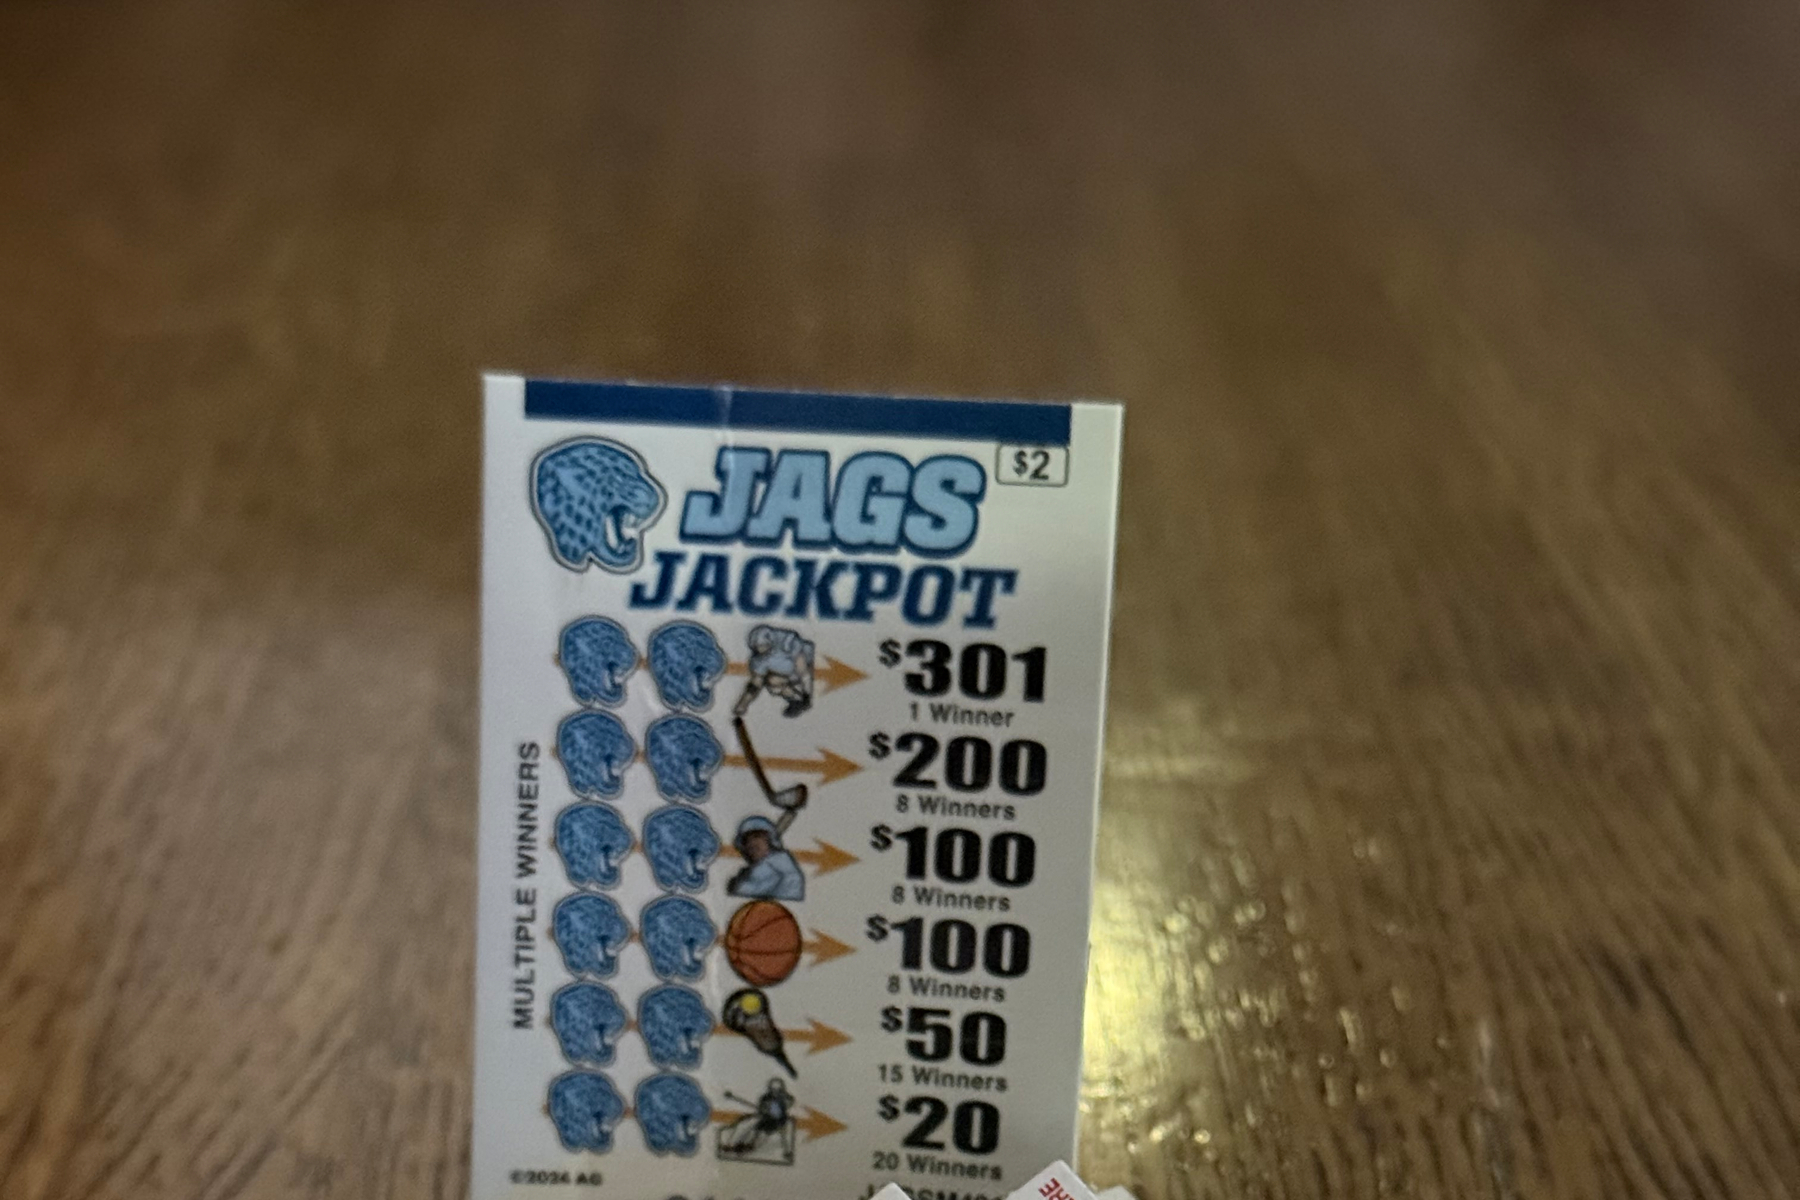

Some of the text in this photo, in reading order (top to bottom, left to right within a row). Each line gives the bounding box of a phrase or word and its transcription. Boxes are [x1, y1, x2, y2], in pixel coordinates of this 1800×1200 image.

[1013, 450, 1050, 480] $2
[680, 446, 987, 559] JAGS
[628, 550, 1018, 628] JACKPOT
[878, 638, 1048, 703] $301
[909, 702, 1015, 728] 1 Winner
[868, 731, 1047, 796] $200
[896, 794, 1016, 820] 8 Winners
[512, 740, 541, 1030] MULTIPLE WINNERS
[869, 823, 1036, 888] $100
[892, 885, 1011, 912] 8 Winners
[866, 913, 1030, 979] $100
[888, 975, 1005, 1002] 8 Winners
[881, 1005, 1007, 1067] $50
[878, 1064, 1008, 1092] 15 Winners
[878, 1093, 1000, 1156] $20
[873, 1151, 1002, 1181] 20 Winners
